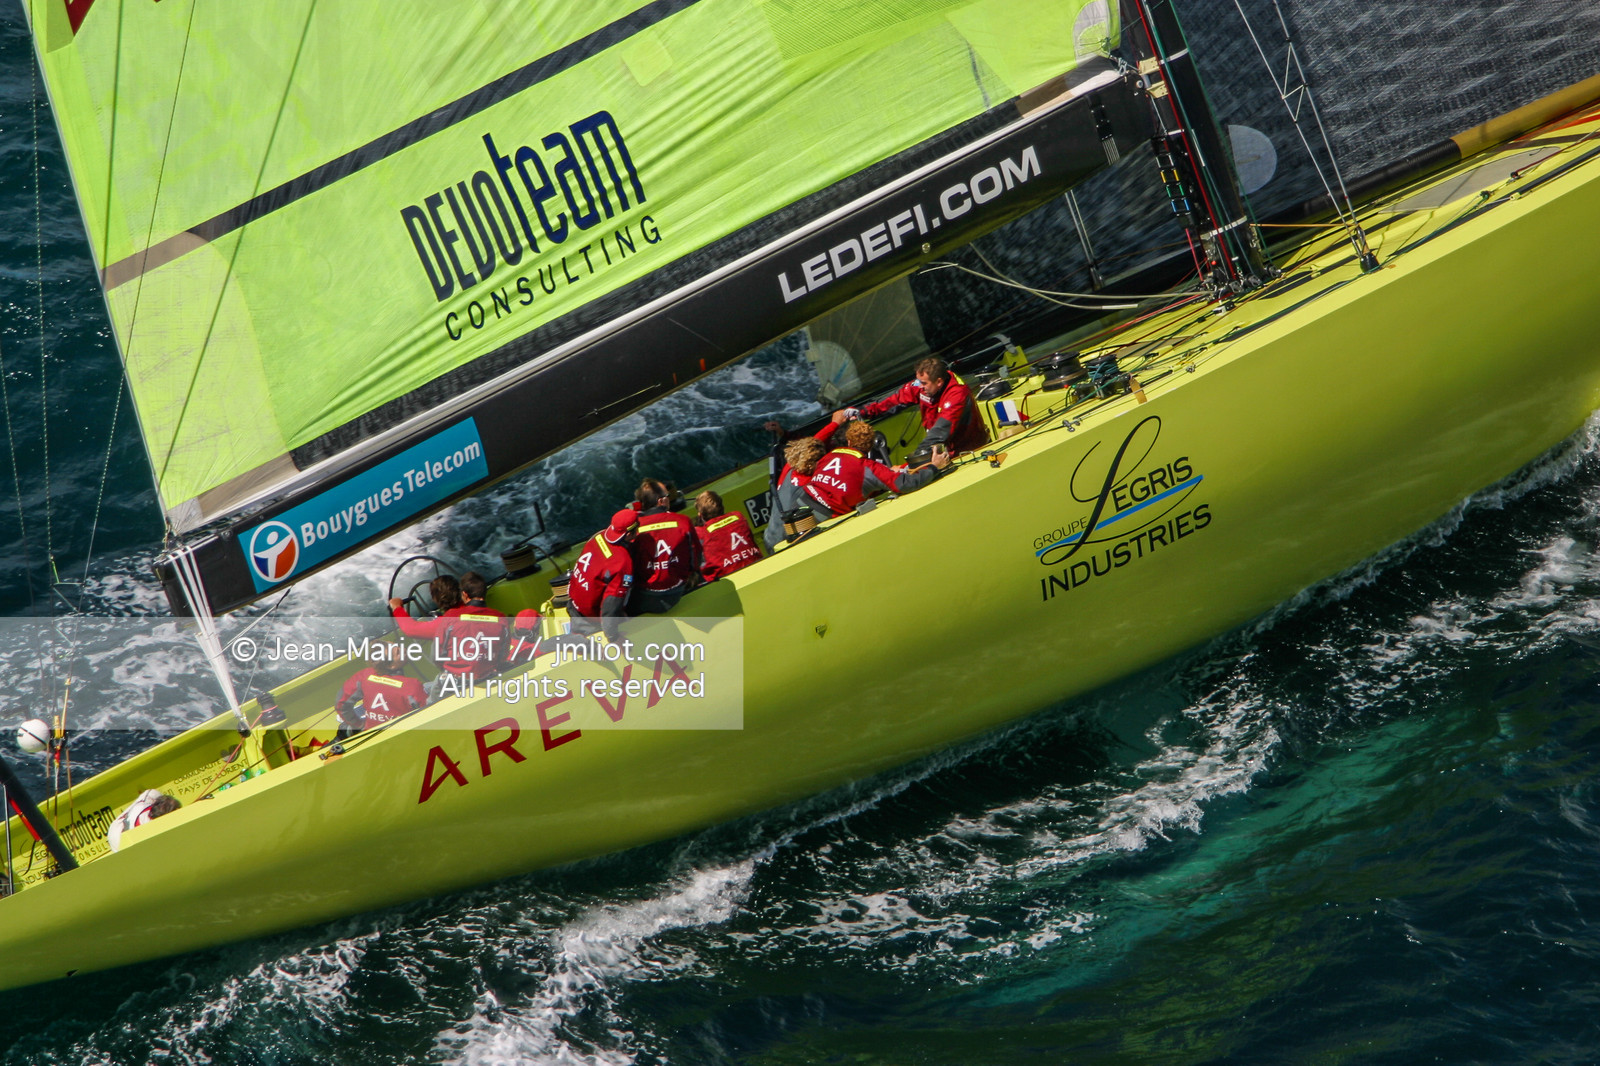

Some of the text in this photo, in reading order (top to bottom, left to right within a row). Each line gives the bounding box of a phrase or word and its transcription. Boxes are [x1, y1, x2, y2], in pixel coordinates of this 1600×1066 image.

[778, 145, 1041, 304] LEDEFI.COM
[446, 215, 662, 340] CONSULTING
[301, 441, 480, 548] Bouygues Telecom
[811, 473, 847, 492] AREVA
[1033, 516, 1087, 550] GROUPE
[723, 547, 760, 568] AREVA
[1040, 504, 1212, 601] INDUSTRIES
[573, 563, 589, 591] EVA
[364, 710, 394, 722] AREV
[418, 651, 696, 804] AREVA
[178, 781, 201, 796] PAYS
[202, 776, 213, 786] DE
